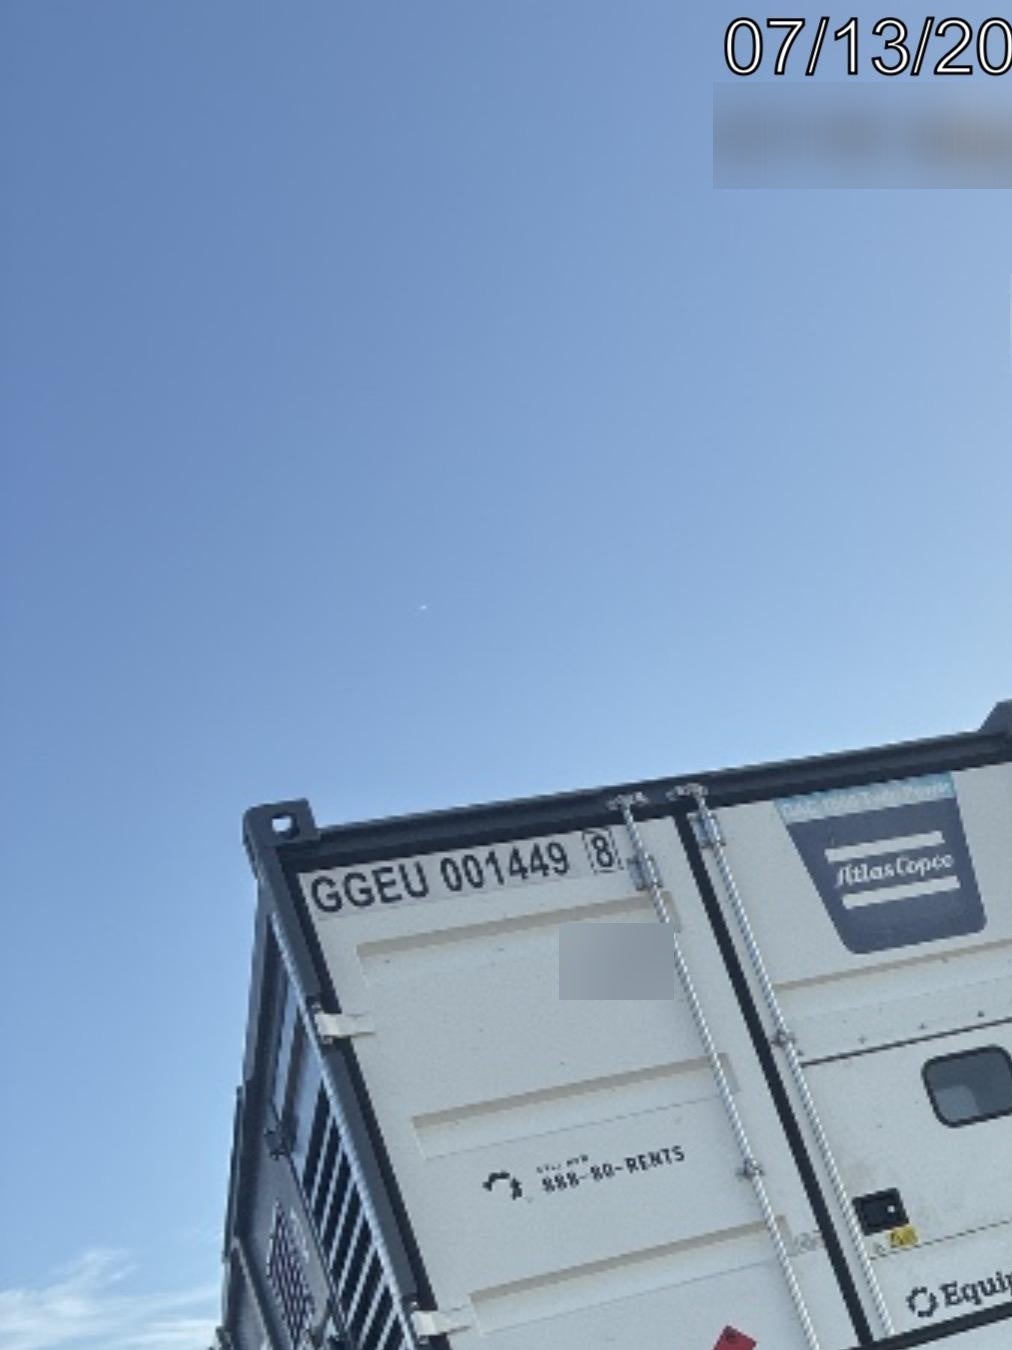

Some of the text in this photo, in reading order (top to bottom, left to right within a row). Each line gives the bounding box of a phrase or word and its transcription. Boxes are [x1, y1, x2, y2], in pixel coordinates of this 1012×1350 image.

[311, 834, 615, 912] GGEU 001449 8
